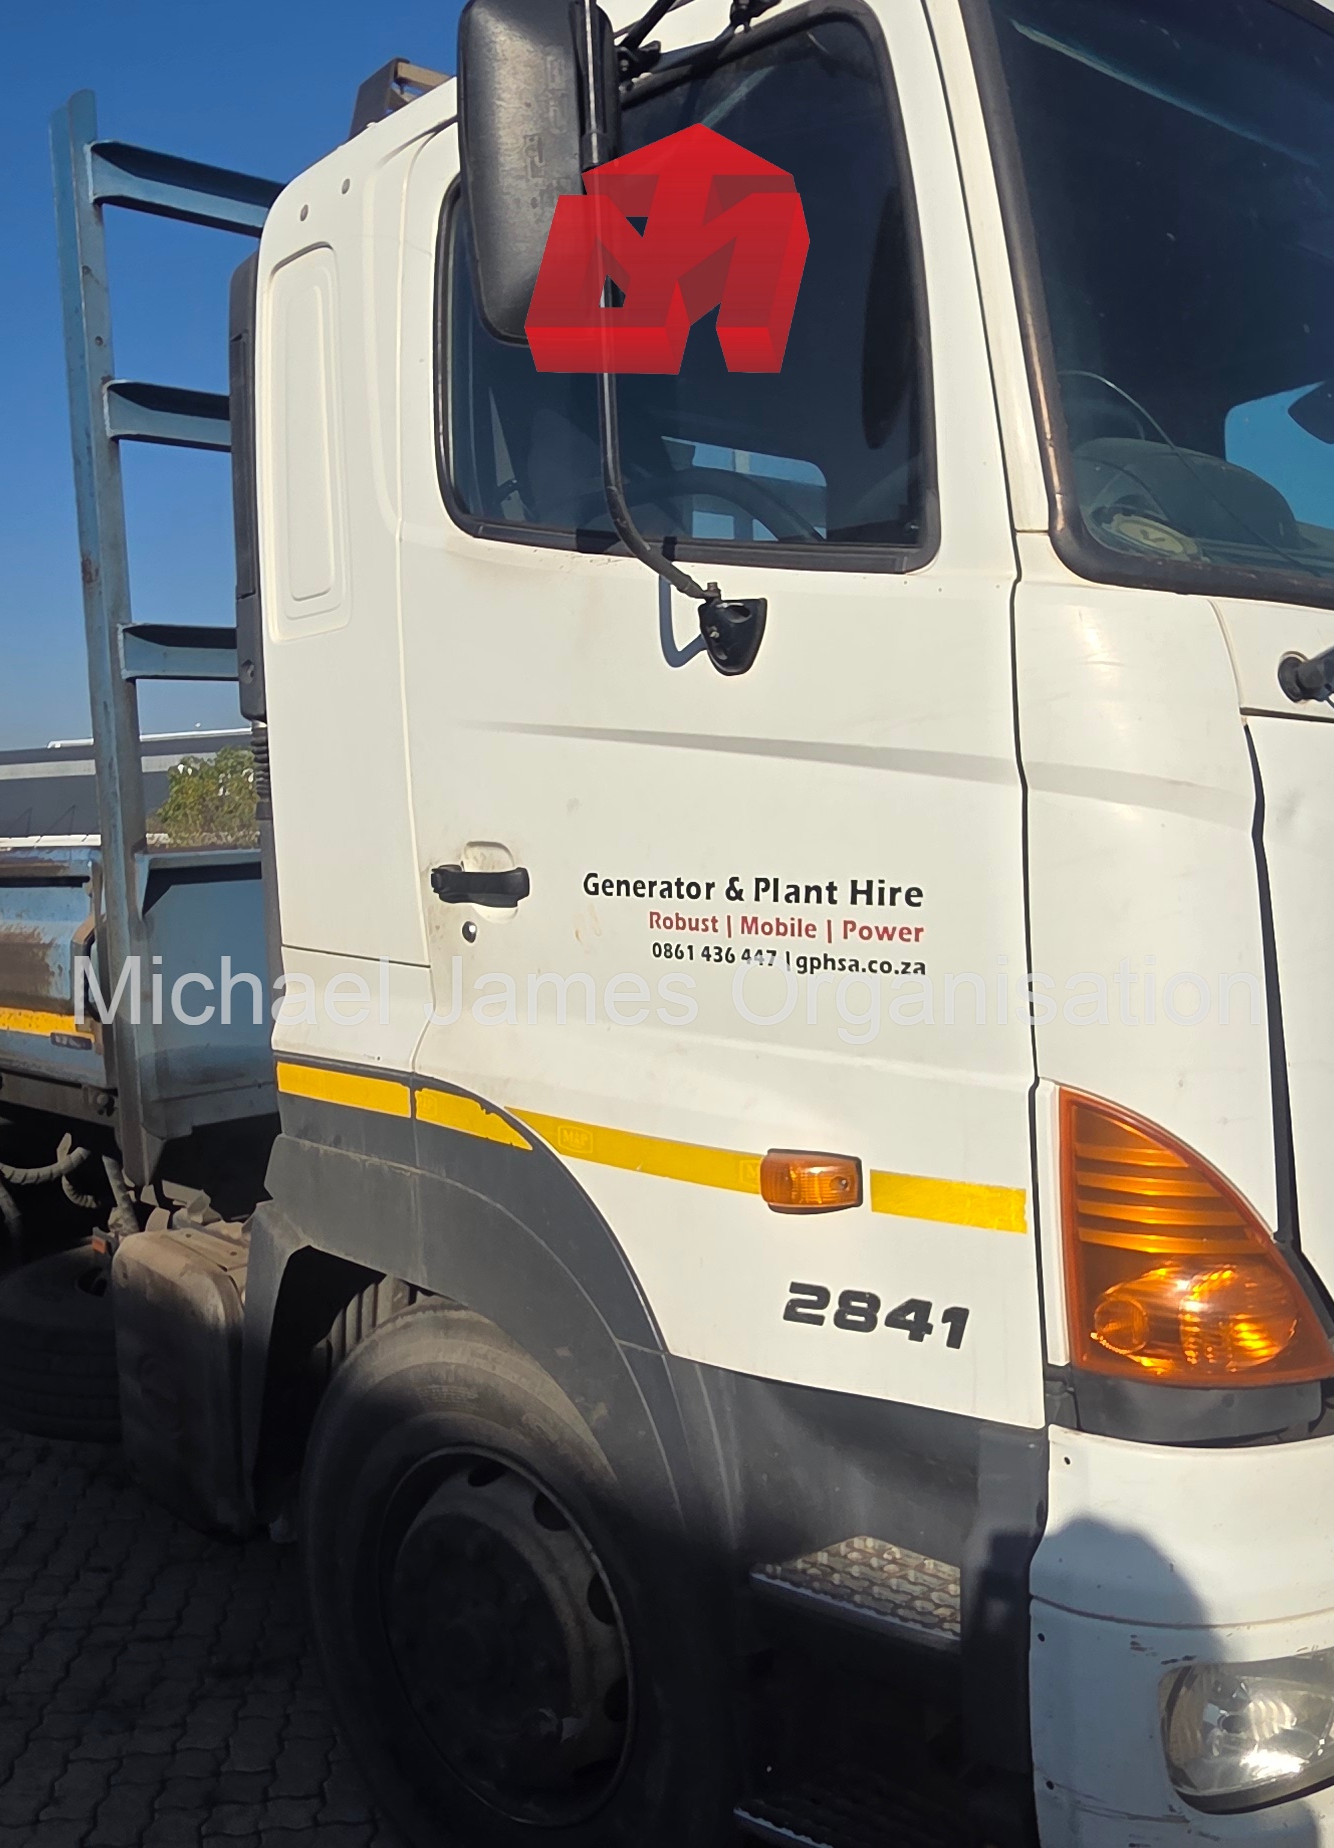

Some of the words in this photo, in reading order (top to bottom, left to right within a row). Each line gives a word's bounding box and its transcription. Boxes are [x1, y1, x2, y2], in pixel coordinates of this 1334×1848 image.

[583, 872, 715, 901] Generator
[725, 876, 744, 902] &
[754, 877, 838, 905] Plant
[849, 879, 924, 907] Hire
[649, 911, 718, 933] Robust
[740, 915, 817, 939] Mobile
[843, 919, 925, 942] Power
[652, 942, 694, 961] 0861
[701, 945, 736, 964] 436
[741, 948, 777, 967] 447
[795, 952, 926, 976] gphsa.co.za
[783, 1281, 970, 1350] 2841
